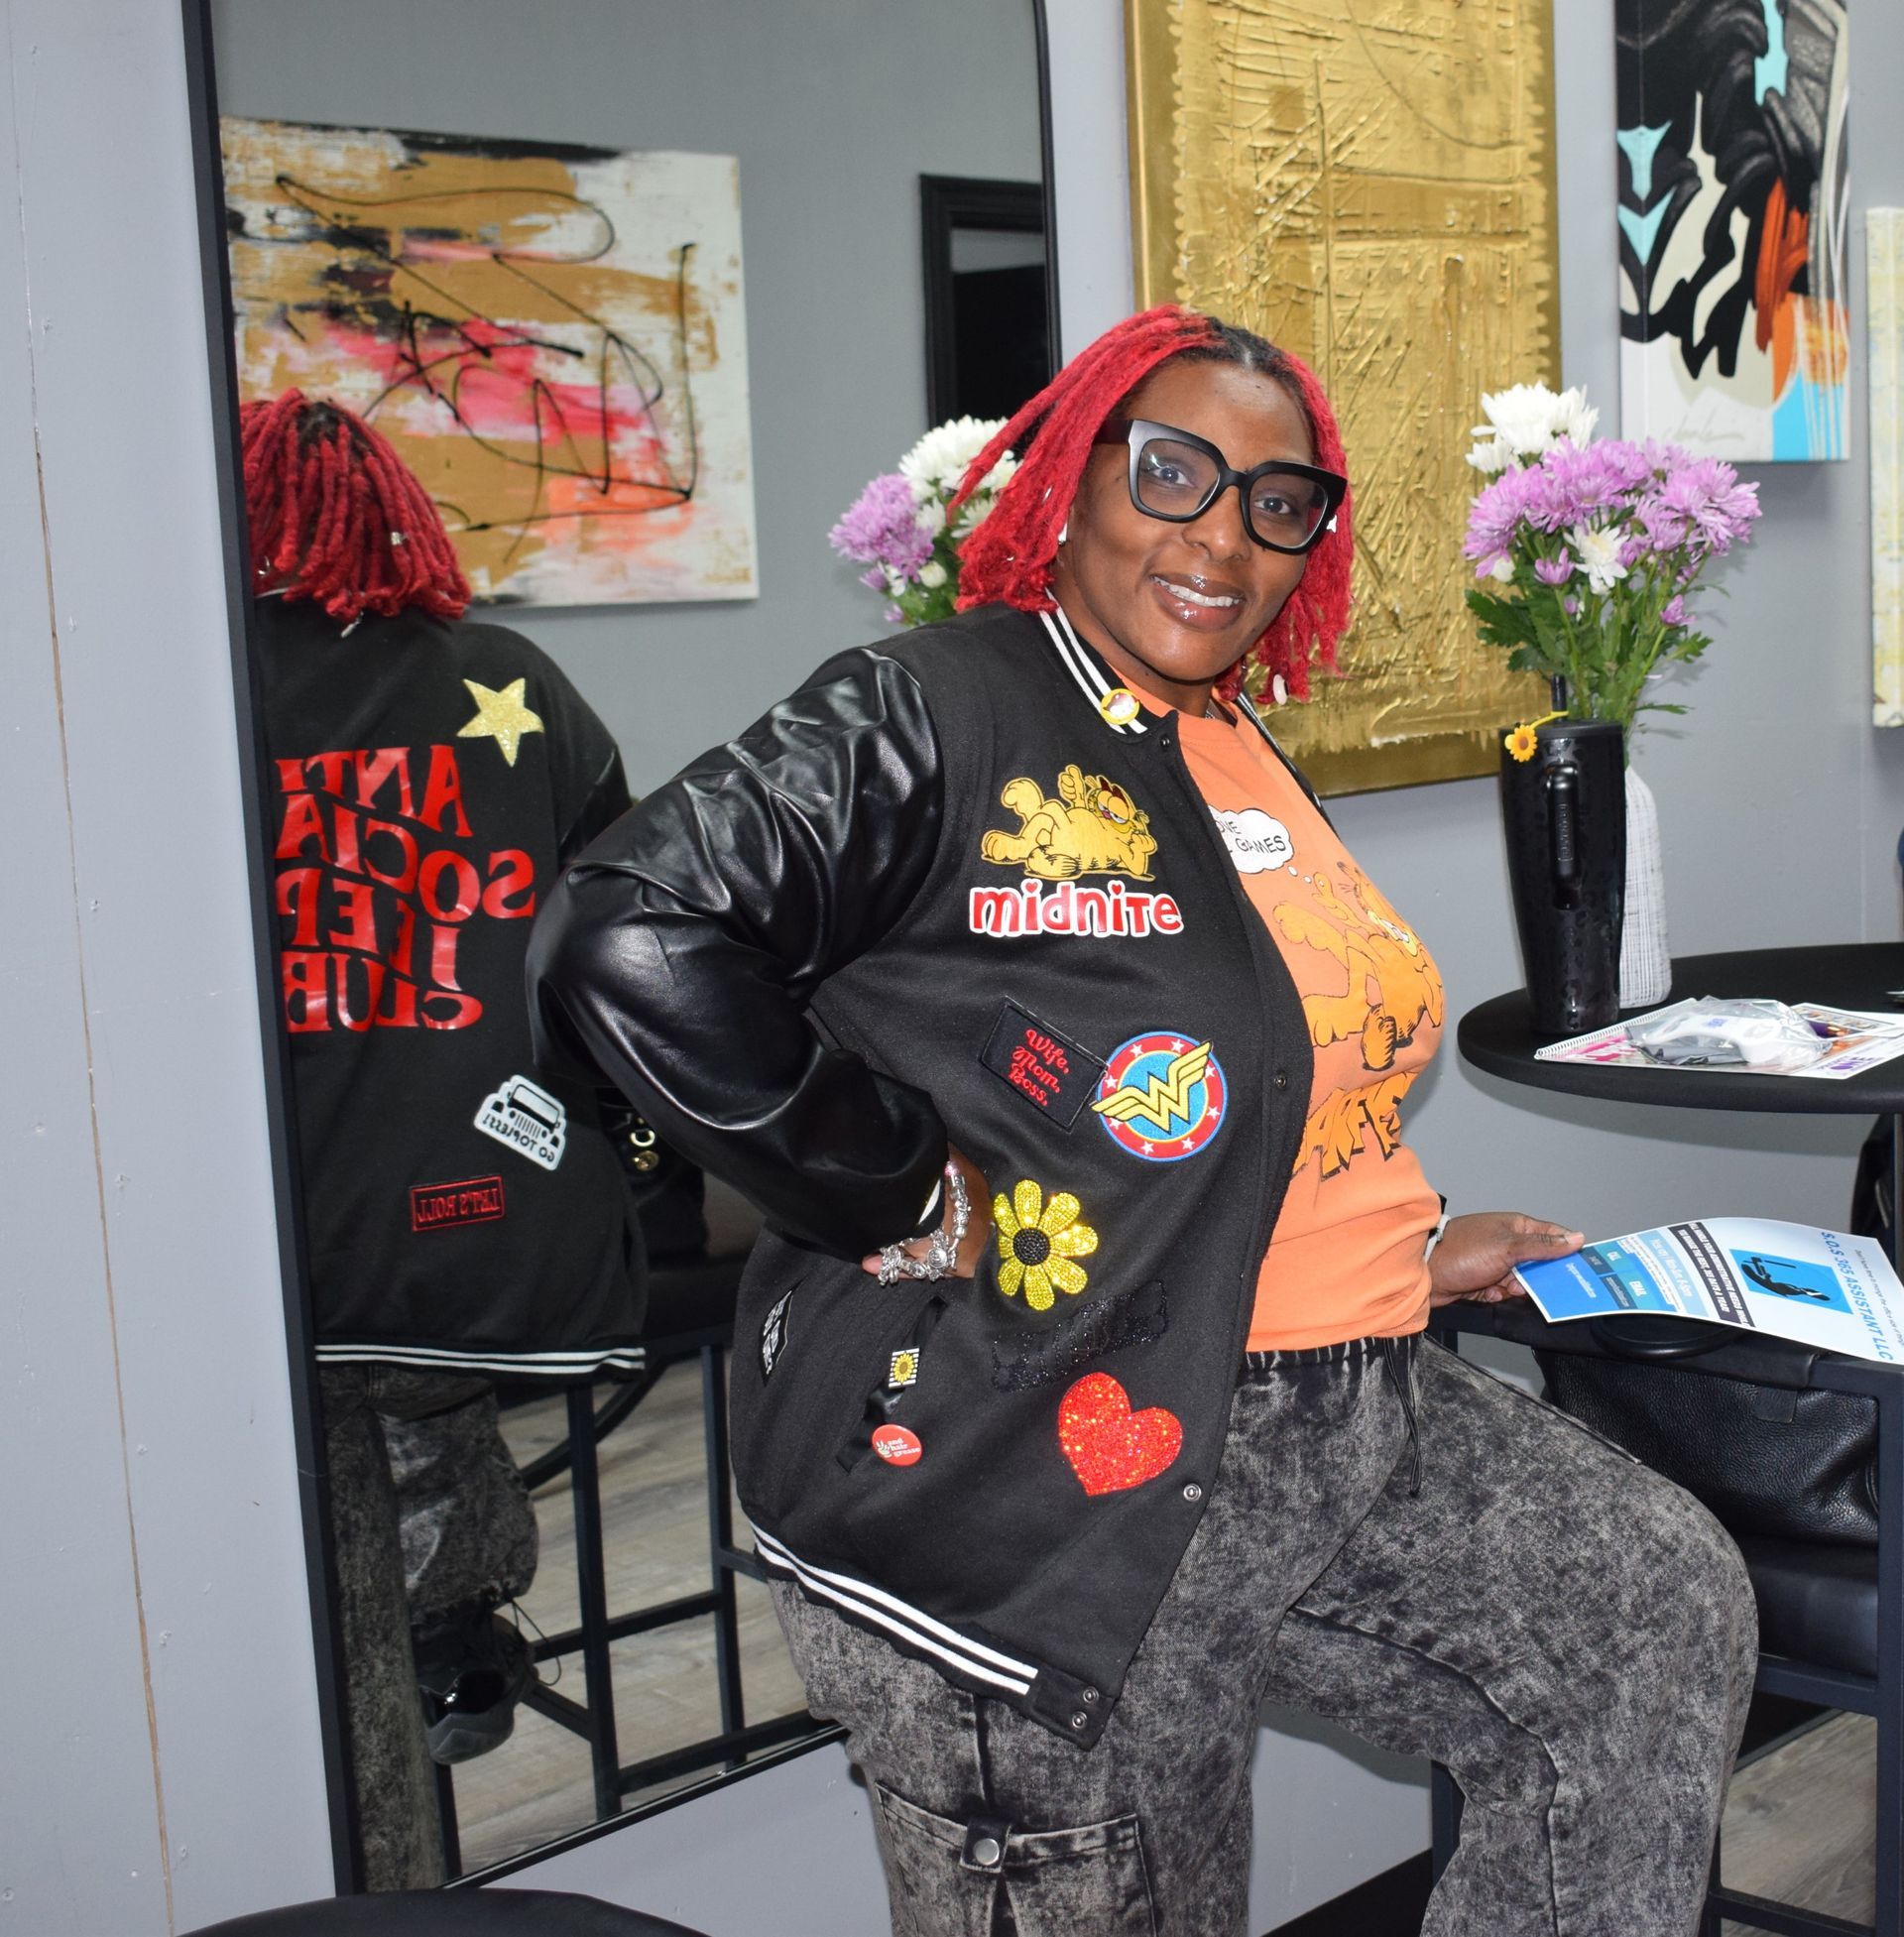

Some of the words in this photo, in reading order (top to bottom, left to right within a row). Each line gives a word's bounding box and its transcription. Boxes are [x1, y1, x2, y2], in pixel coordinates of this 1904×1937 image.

[1235, 835, 1286, 854] GAMES
[1025, 1029, 1069, 1073] Wife,
[1835, 1257, 1855, 1276] 365
[1727, 1291, 1743, 1310] NEEDS
[1844, 1275, 1884, 1337] ASSISTANT
[1872, 1336, 1894, 1361] LLC
